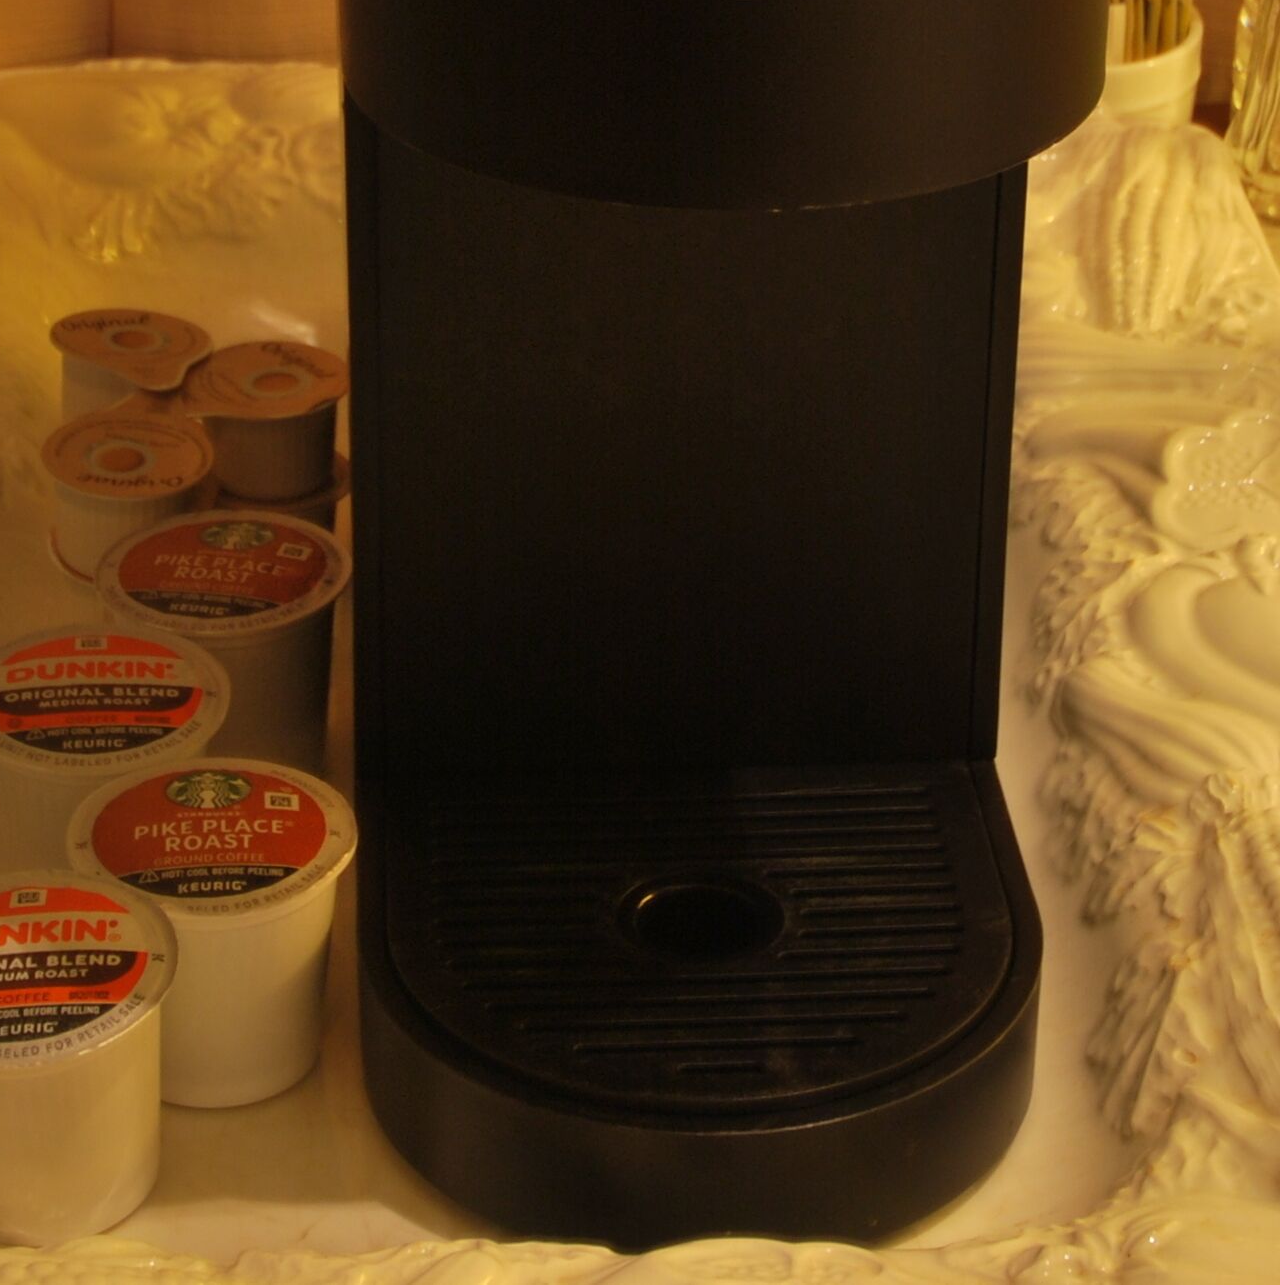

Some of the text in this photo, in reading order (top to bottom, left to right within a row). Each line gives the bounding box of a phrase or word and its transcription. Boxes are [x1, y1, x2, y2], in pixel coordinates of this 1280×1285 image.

[154, 554, 288, 577] PIKE PLACE
[173, 566, 256, 584] ROAST
[169, 602, 225, 615] KEURIG
[4, 686, 180, 703] ORIGINAL BLEND
[39, 696, 152, 707] MEDIUM ROAST
[134, 818, 285, 840] PIKE PLACE
[165, 833, 254, 852] ROAST
[154, 852, 265, 866] GROUND COFFEE
[212, 867, 244, 876] BEFORE
[247, 867, 284, 877] PEELING
[178, 881, 246, 894] KEURIG
[46, 953, 121, 967] BLEND
[35, 968, 89, 979] ROAST
[24, 1007, 58, 1017] BEFORE
[61, 1005, 100, 1015] PEELING
[45, 1035, 74, 1054] FOR
[77, 1017, 120, 1043] RETAIL
[119, 992, 147, 1017] SALE
